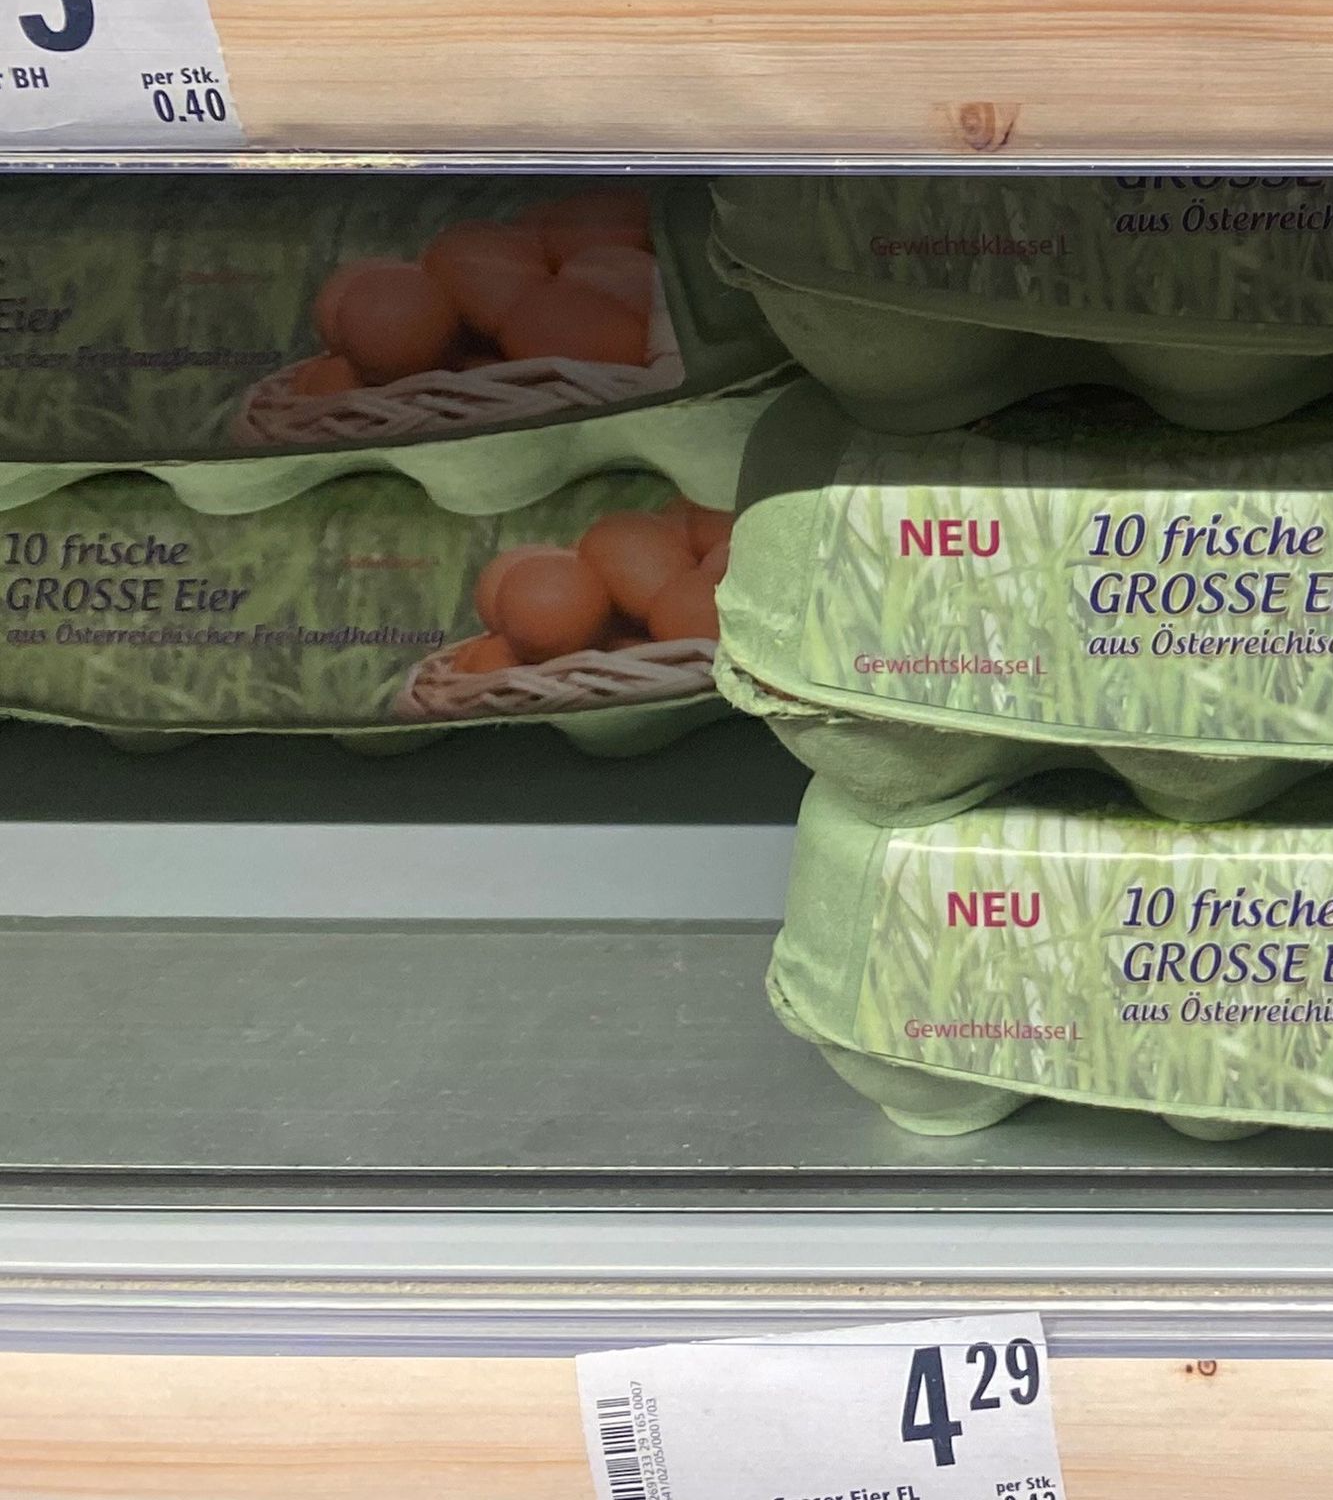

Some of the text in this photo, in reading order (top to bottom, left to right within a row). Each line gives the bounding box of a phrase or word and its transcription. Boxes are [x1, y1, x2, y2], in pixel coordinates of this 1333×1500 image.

[11, 67, 49, 88] BH
[141, 71, 174, 88] per
[181, 67, 219, 84] Stk.
[153, 88, 226, 122] 0.40
[1115, 208, 1171, 233] aus
[4, 532, 188, 570] 10 frische
[900, 514, 1325, 566] NEU 10 frische
[6, 577, 249, 613] GROSSE Eier
[1089, 571, 1289, 616] GROSSE
[1089, 633, 1140, 657] aus
[947, 891, 1042, 929] NEU
[1121, 887, 1176, 928] 10
[1122, 941, 1309, 985] GROSSE
[1121, 1001, 1171, 1024] aus
[629, 1380, 644, 1410] 0007
[901, 1337, 1041, 1468] 4 29
[996, 1480, 1021, 1497] per
[1026, 1475, 1057, 1492] Stk.
